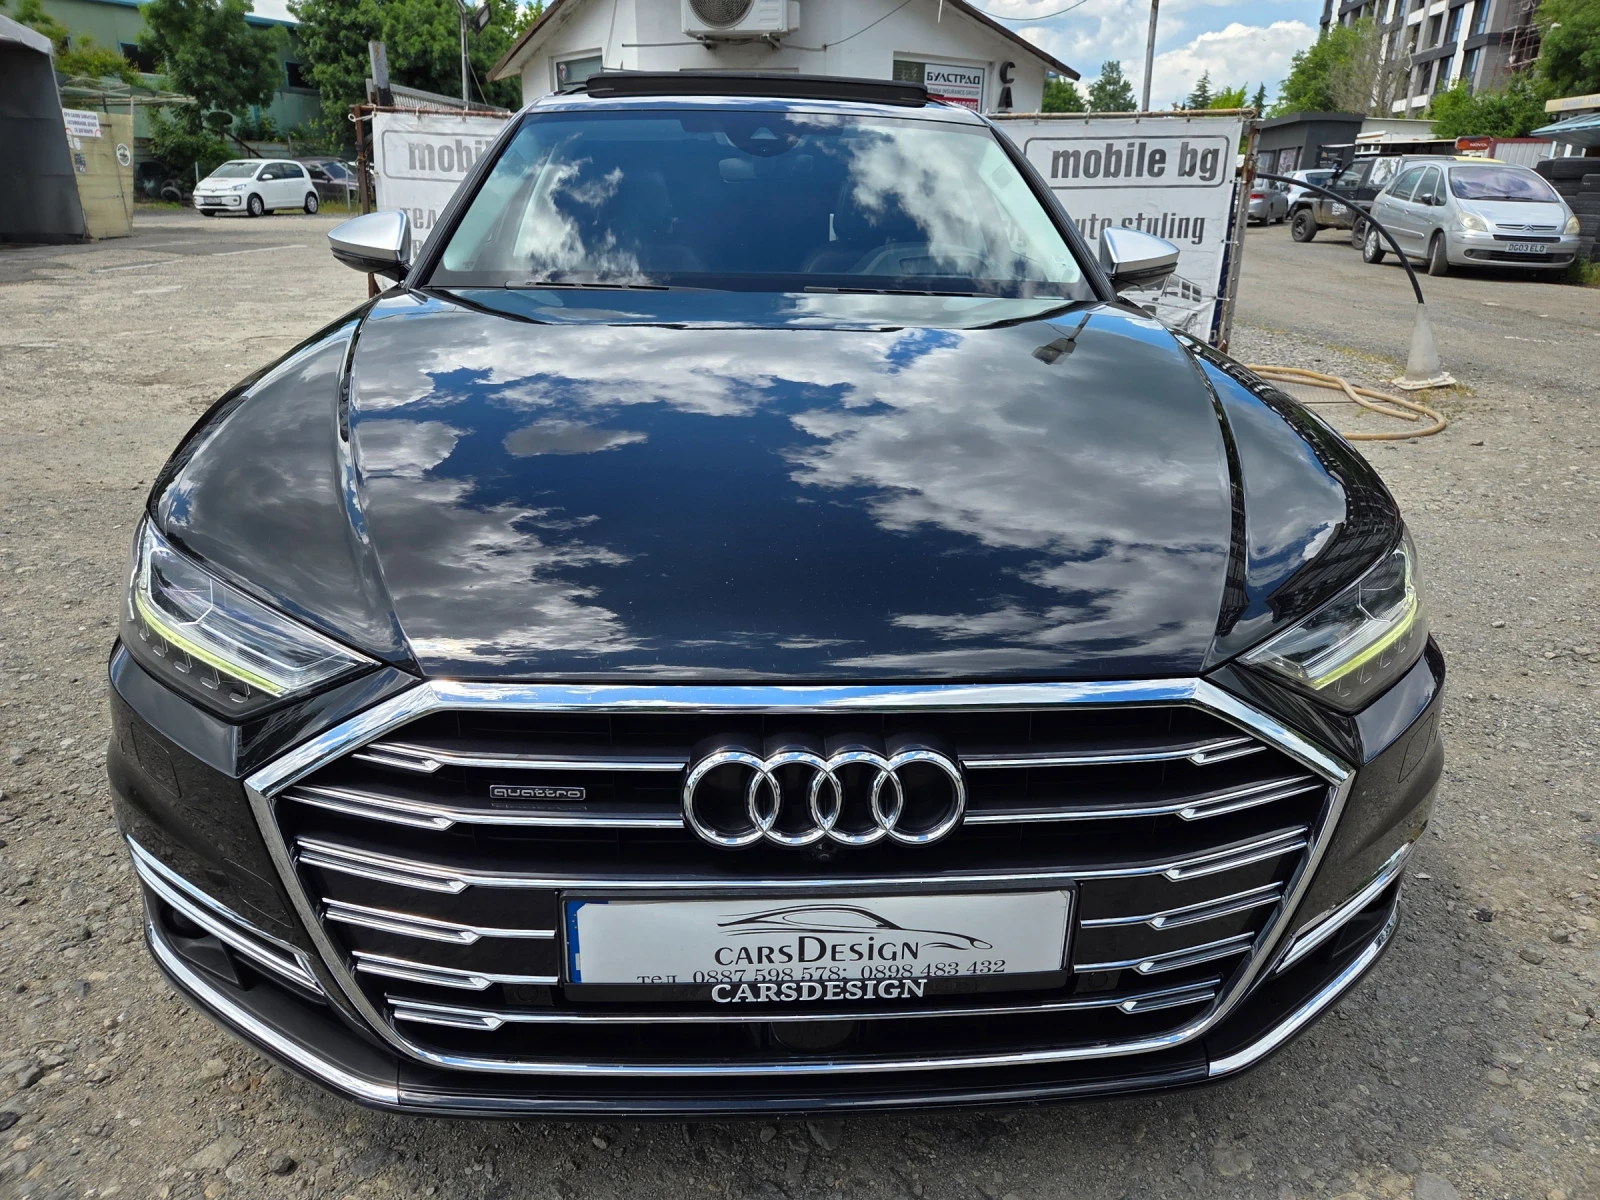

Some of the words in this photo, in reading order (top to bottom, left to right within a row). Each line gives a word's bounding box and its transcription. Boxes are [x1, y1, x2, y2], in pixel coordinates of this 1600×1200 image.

[408, 139, 490, 172] mob
[1050, 142, 1167, 179] mobile
[1177, 141, 1220, 182] bg
[494, 788, 580, 798] quattro
[692, 969, 747, 984] 0887
[754, 967, 794, 982] 598
[860, 963, 914, 979] 0898
[920, 961, 960, 977] 483
[966, 959, 1006, 974] 432
[710, 978, 929, 1003] CARSDESIGN
